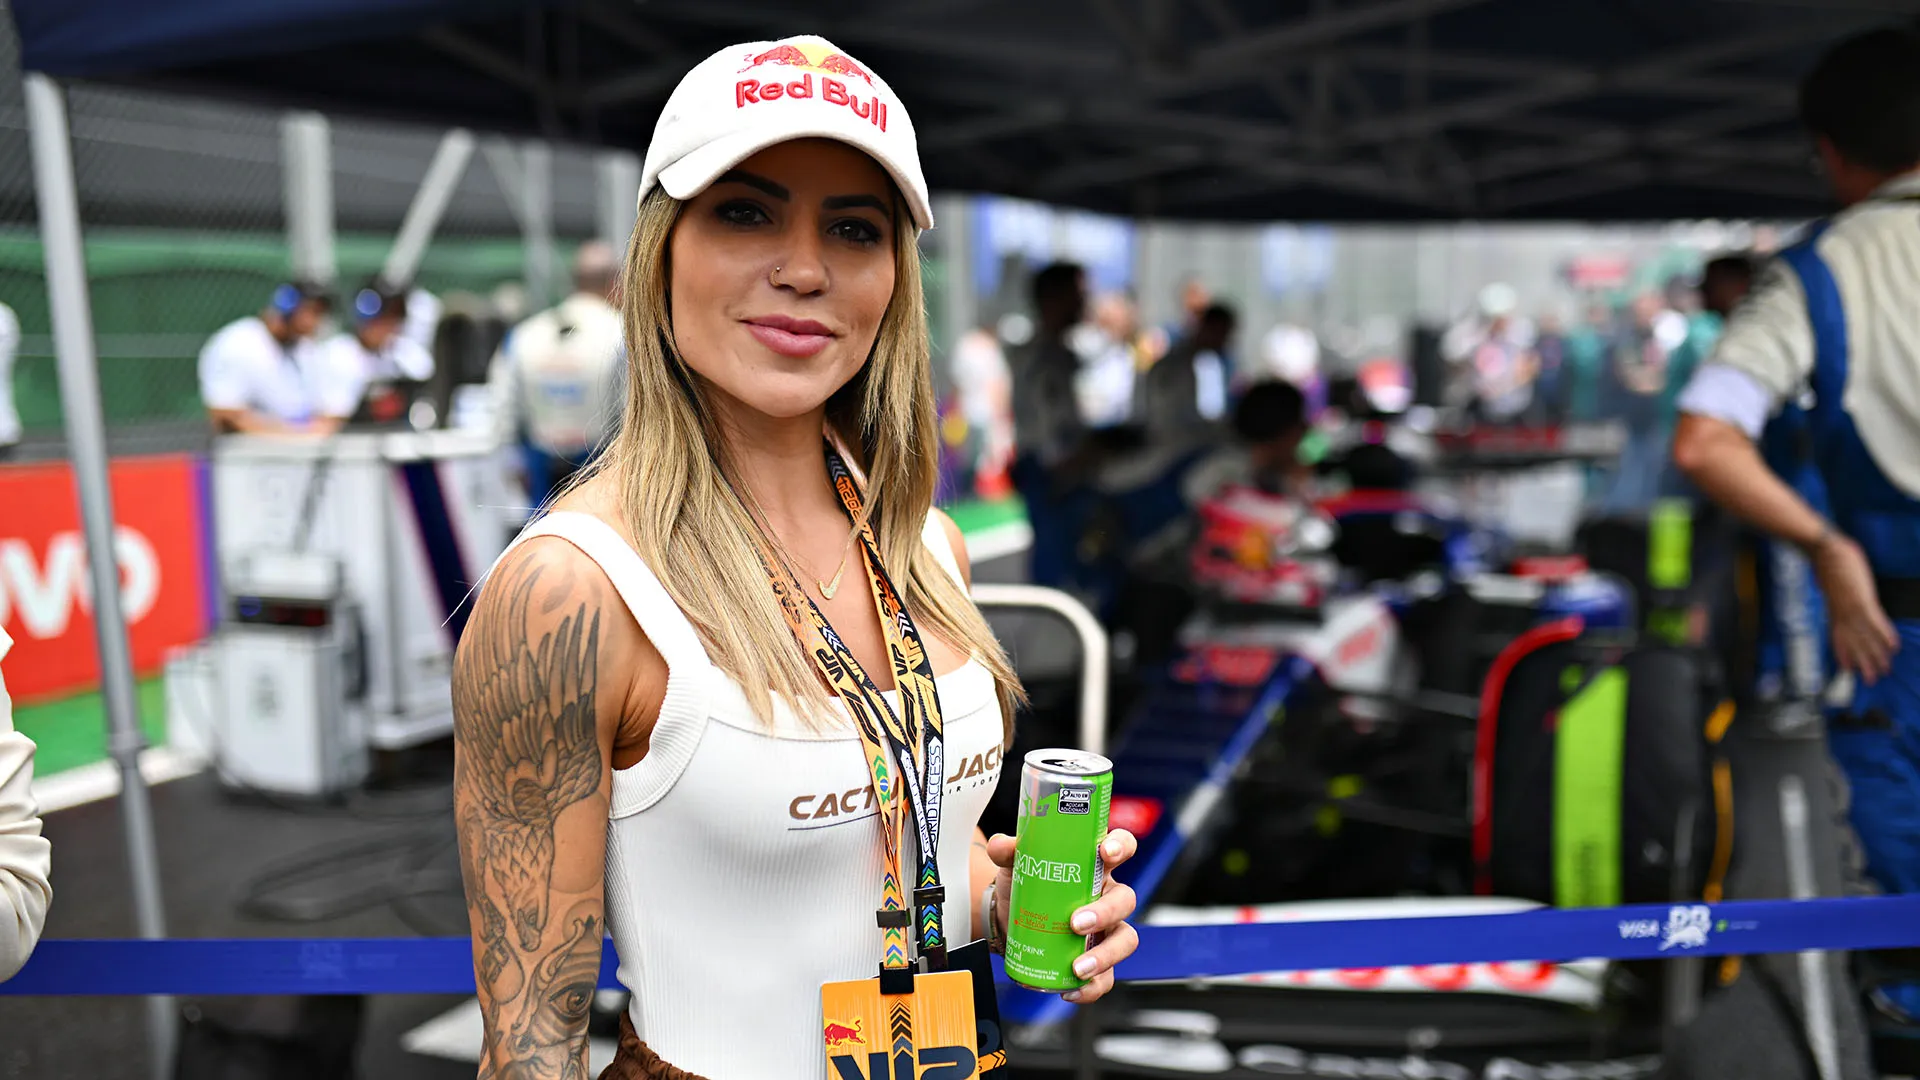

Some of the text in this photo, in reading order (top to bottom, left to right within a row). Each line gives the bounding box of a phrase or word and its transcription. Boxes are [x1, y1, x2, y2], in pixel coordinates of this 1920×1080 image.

[736, 74, 887, 132] Red Bull
[815, 648, 844, 683] VIP
[903, 635, 924, 671] VIP
[928, 745, 941, 805] ACCESS
[789, 776, 900, 820] CACT
[1015, 850, 1081, 883] MMER
